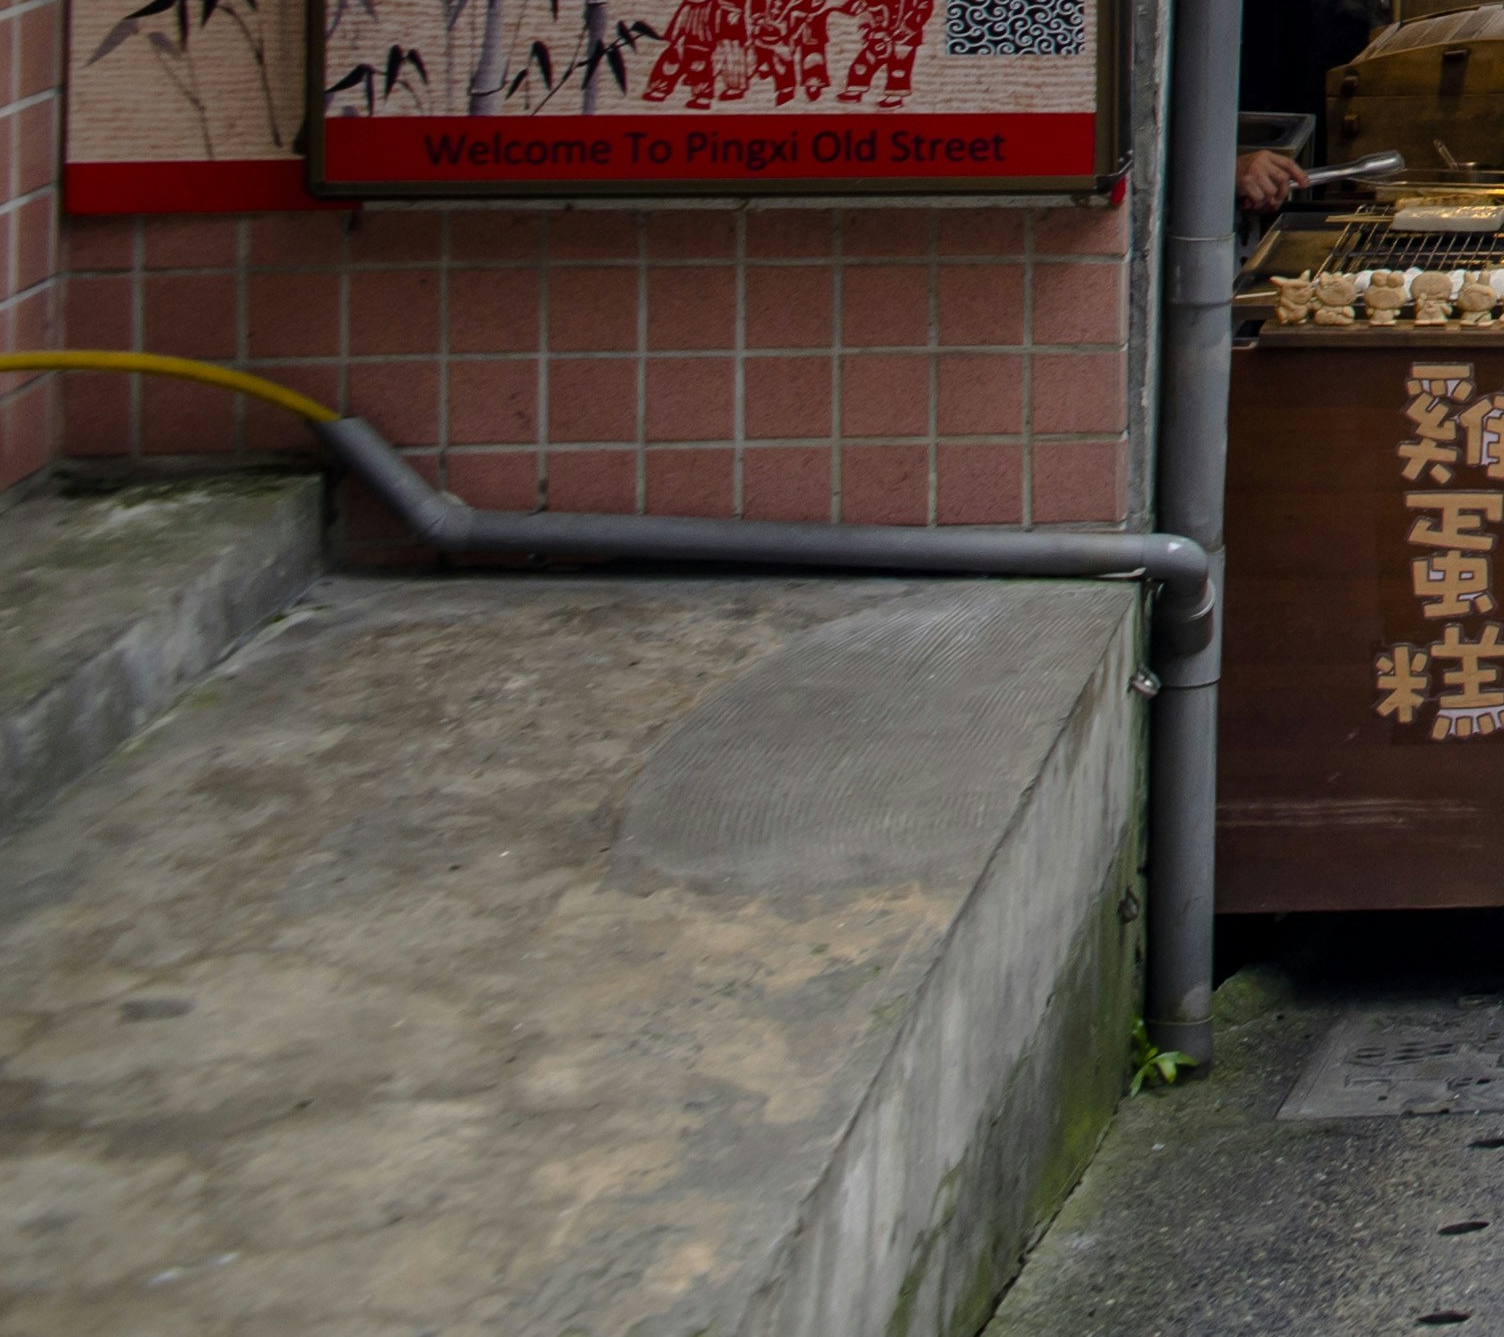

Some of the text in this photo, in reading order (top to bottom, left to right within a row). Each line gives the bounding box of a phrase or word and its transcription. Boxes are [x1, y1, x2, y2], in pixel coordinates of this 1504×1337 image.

[424, 126, 1008, 178] Welcome To Pingxi Old Street
